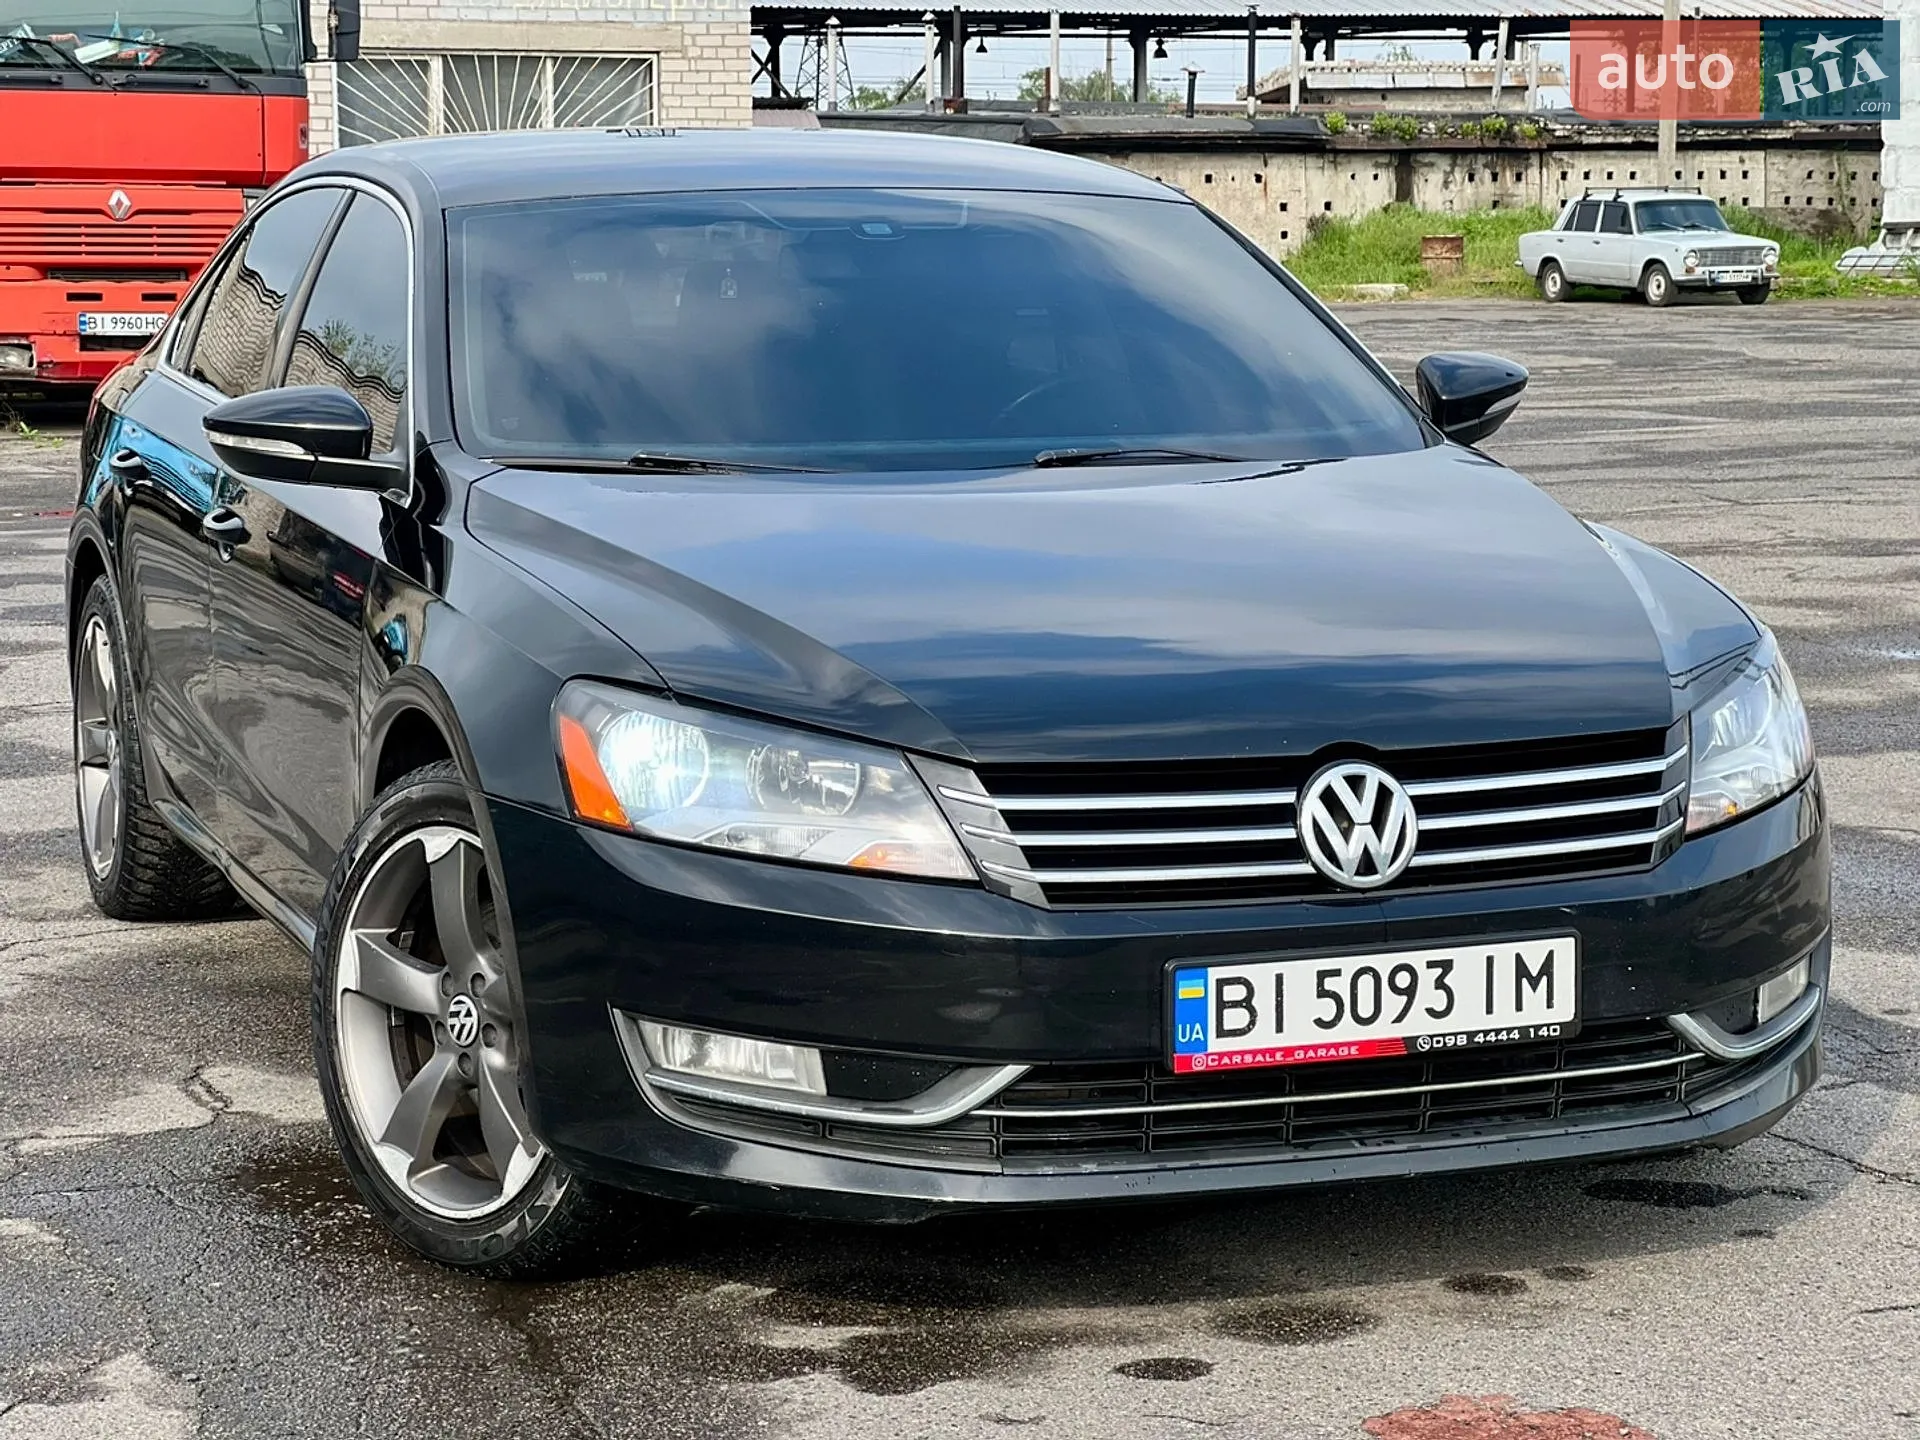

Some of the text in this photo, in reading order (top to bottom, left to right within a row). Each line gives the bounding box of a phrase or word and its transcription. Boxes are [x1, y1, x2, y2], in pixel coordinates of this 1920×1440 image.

[111, 316, 143, 330] 9960
[1216, 949, 1554, 1039] BI 5093 IM
[1178, 1023, 1204, 1042] UA
[1432, 1025, 1560, 1047] 098 4444 140
[1207, 1045, 1359, 1067] CARSALE_GARAGE
